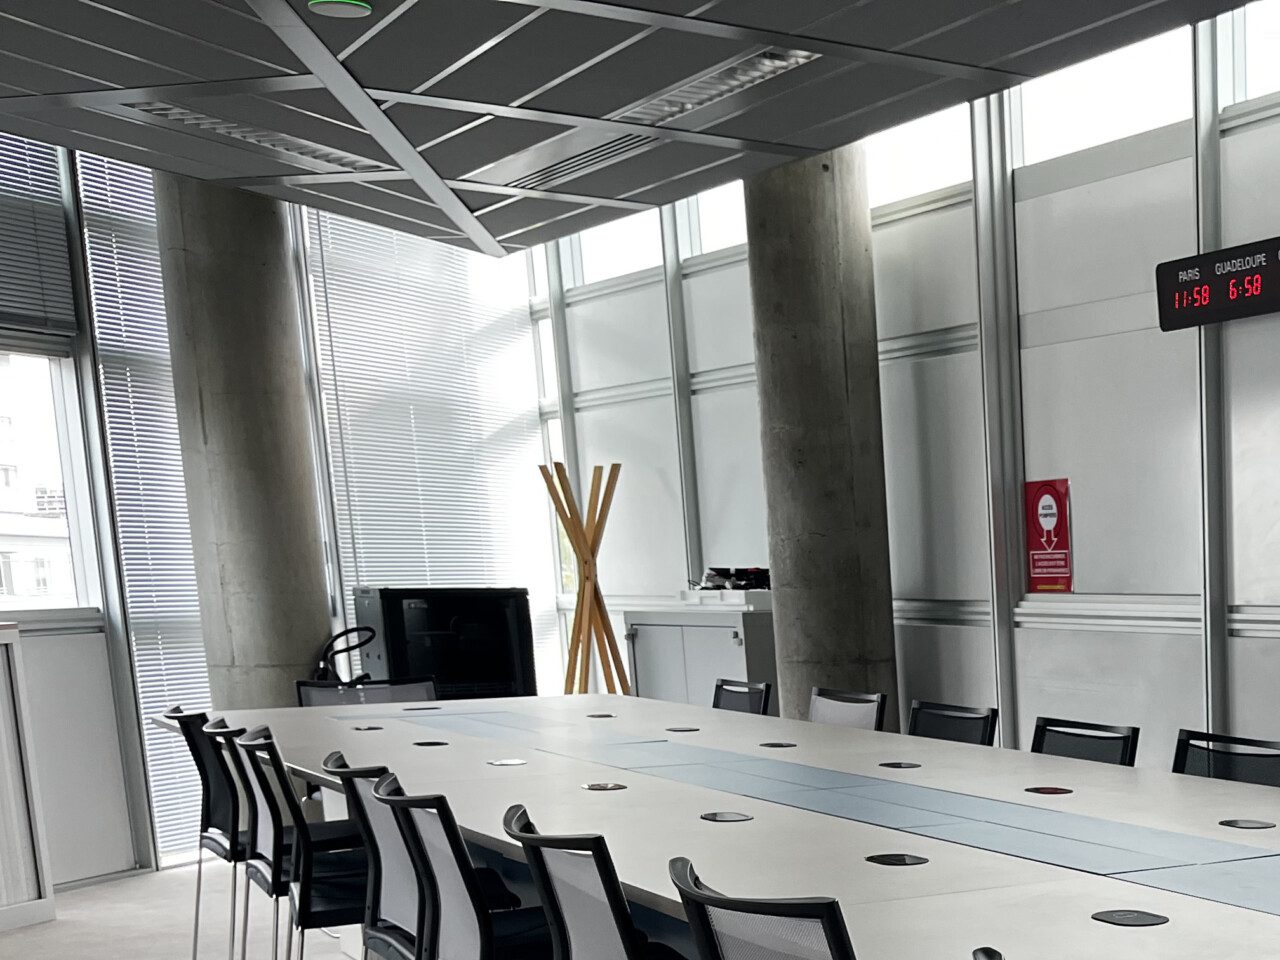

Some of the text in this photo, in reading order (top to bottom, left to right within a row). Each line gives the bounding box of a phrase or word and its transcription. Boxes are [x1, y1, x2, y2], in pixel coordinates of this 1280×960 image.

[1178, 268, 1201, 283] PARIS
[1214, 253, 1267, 275] GUADELOUPE
[1174, 284, 1210, 309] 11:58
[1229, 274, 1262, 300] 6:58
